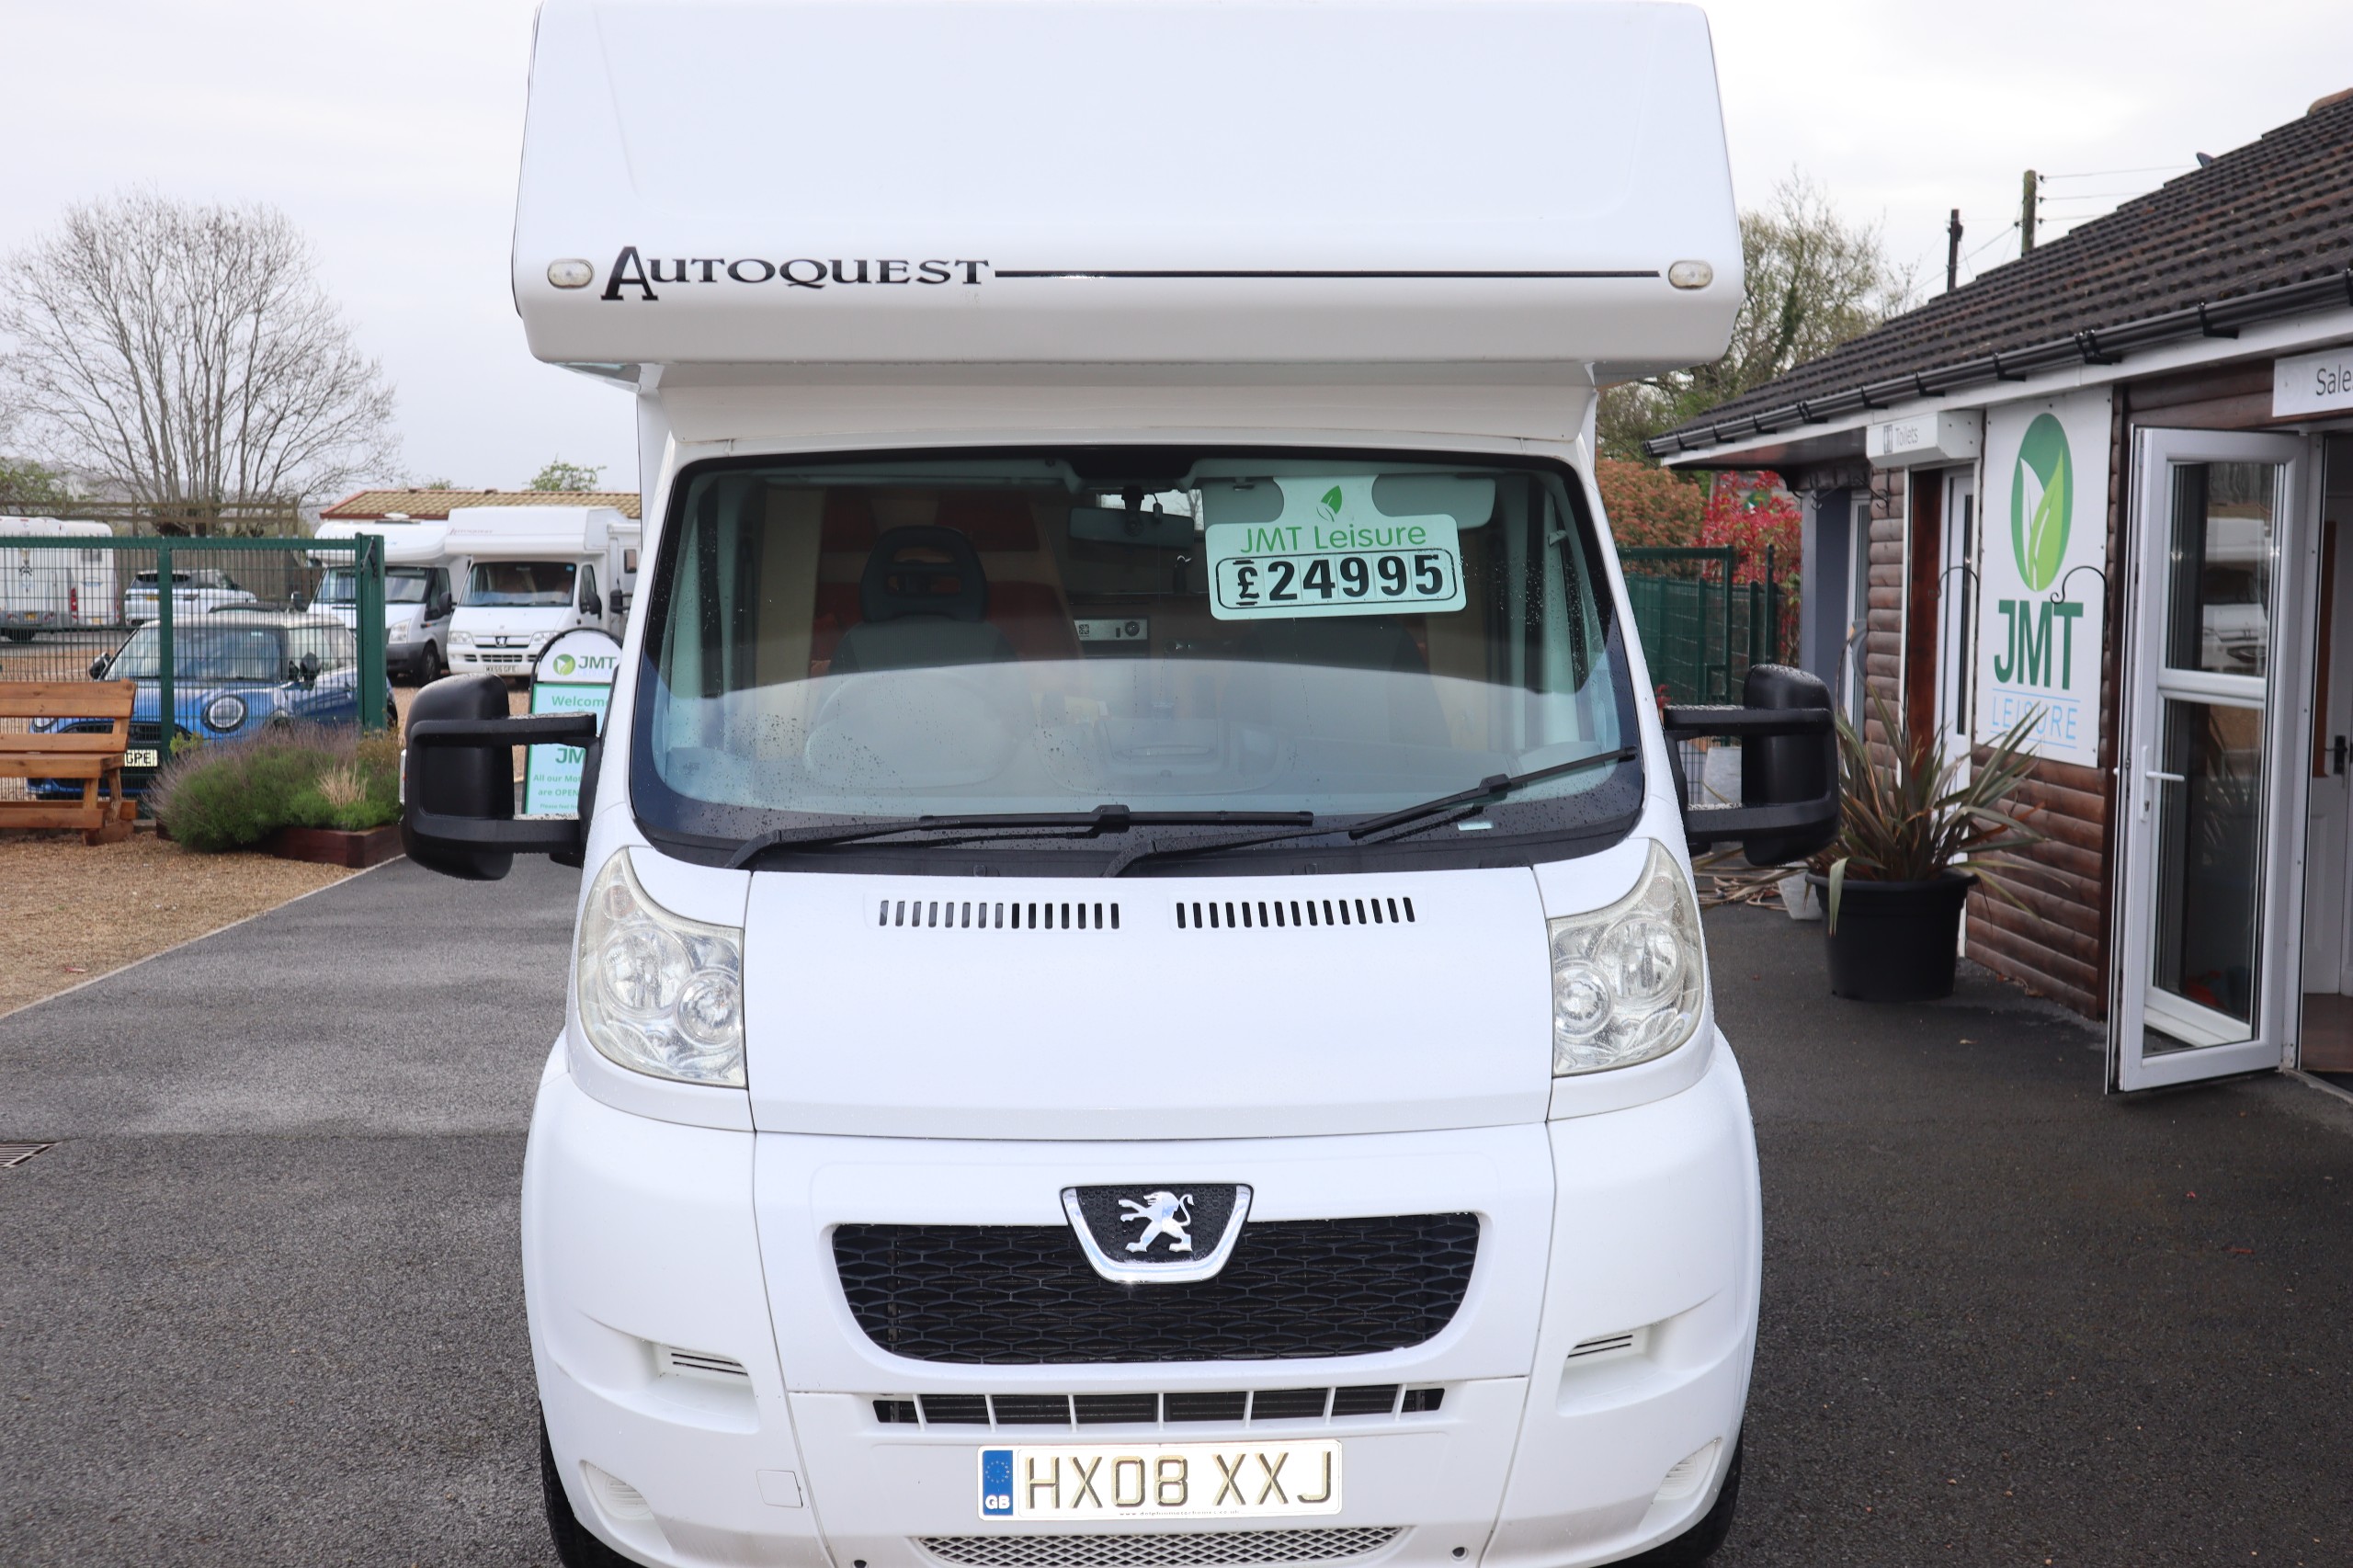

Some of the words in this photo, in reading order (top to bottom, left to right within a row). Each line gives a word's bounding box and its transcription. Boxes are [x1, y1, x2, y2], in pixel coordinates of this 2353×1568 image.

[600, 245, 990, 301] AUTOQUEST
[2316, 363, 2353, 396] Sale
[1895, 426, 1919, 448] Toilets
[1241, 526, 1302, 553] JMT
[1313, 524, 1427, 550] Leisure
[1236, 553, 1444, 602] £24995
[1994, 598, 2084, 691] JMT
[578, 655, 618, 669] JMT
[551, 696, 608, 707] Welcom
[1991, 696, 2078, 741] LEISURE
[555, 747, 586, 764] JM
[1025, 1454, 1188, 1509] HX08
[1211, 1451, 1333, 1506] XXJ
[984, 1494, 1010, 1510] GB
